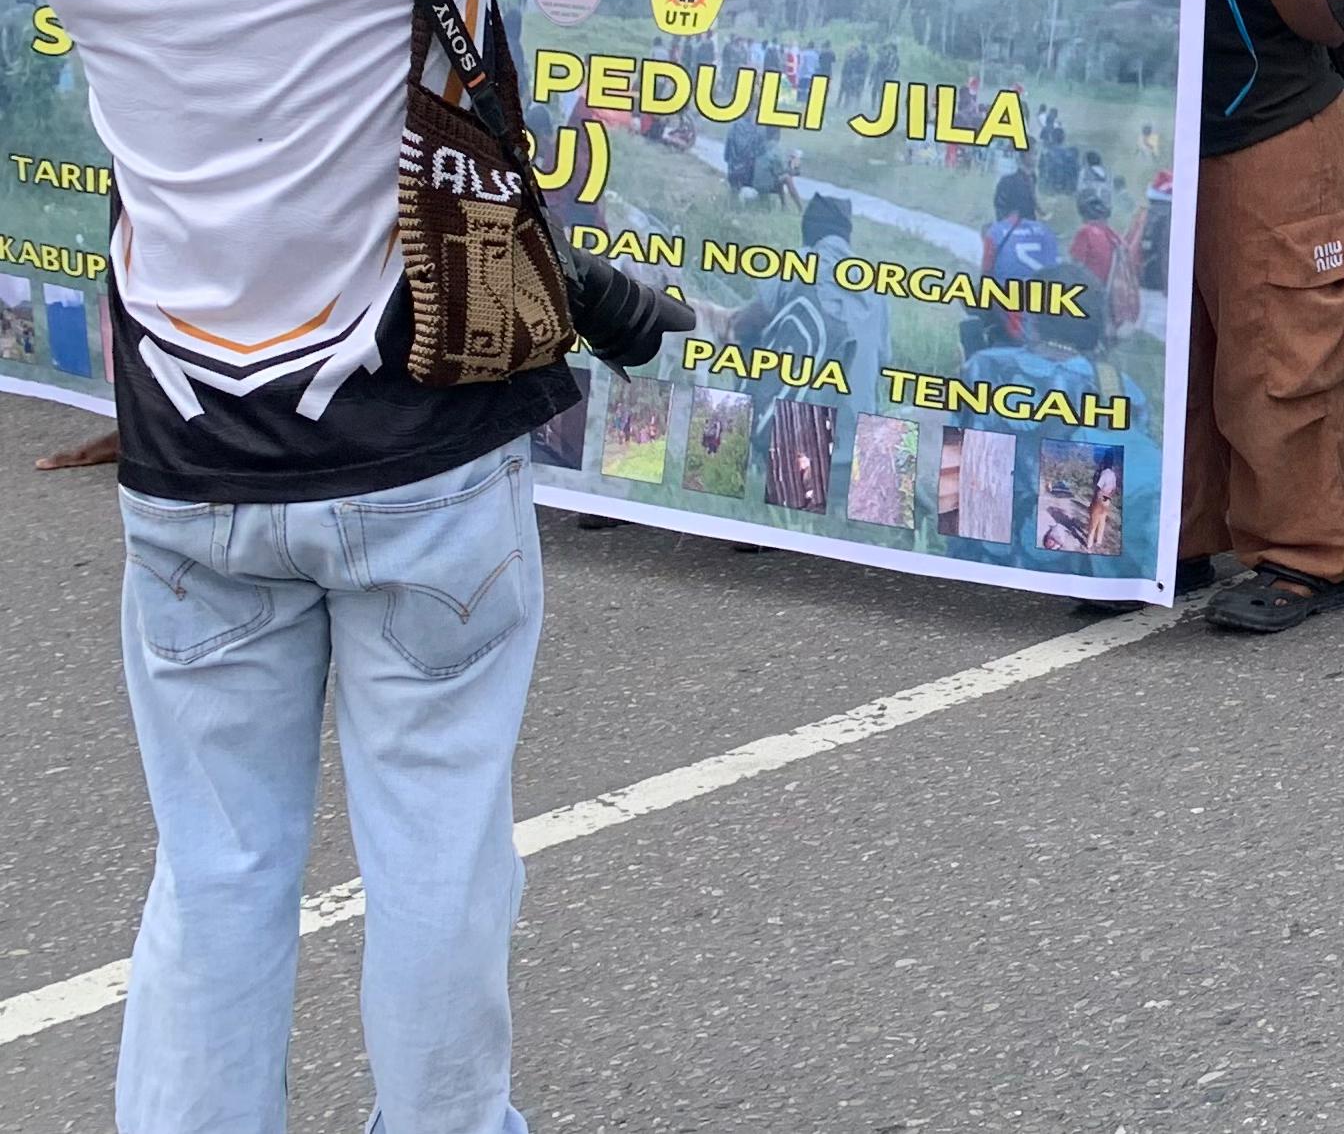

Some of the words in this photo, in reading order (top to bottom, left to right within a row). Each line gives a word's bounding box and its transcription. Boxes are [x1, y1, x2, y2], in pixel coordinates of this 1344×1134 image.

[431, 2, 478, 72] SONY
[664, 9, 699, 28] UTI
[533, 48, 831, 132] PEDULI
[847, 79, 1030, 151] JILA
[0, 234, 108, 281] KABUP
[570, 223, 686, 268] DAN
[701, 239, 819, 285] NON
[832, 256, 1090, 320] ORGANIK
[682, 336, 853, 395] PAPUA
[880, 365, 1131, 431] TENGAH
